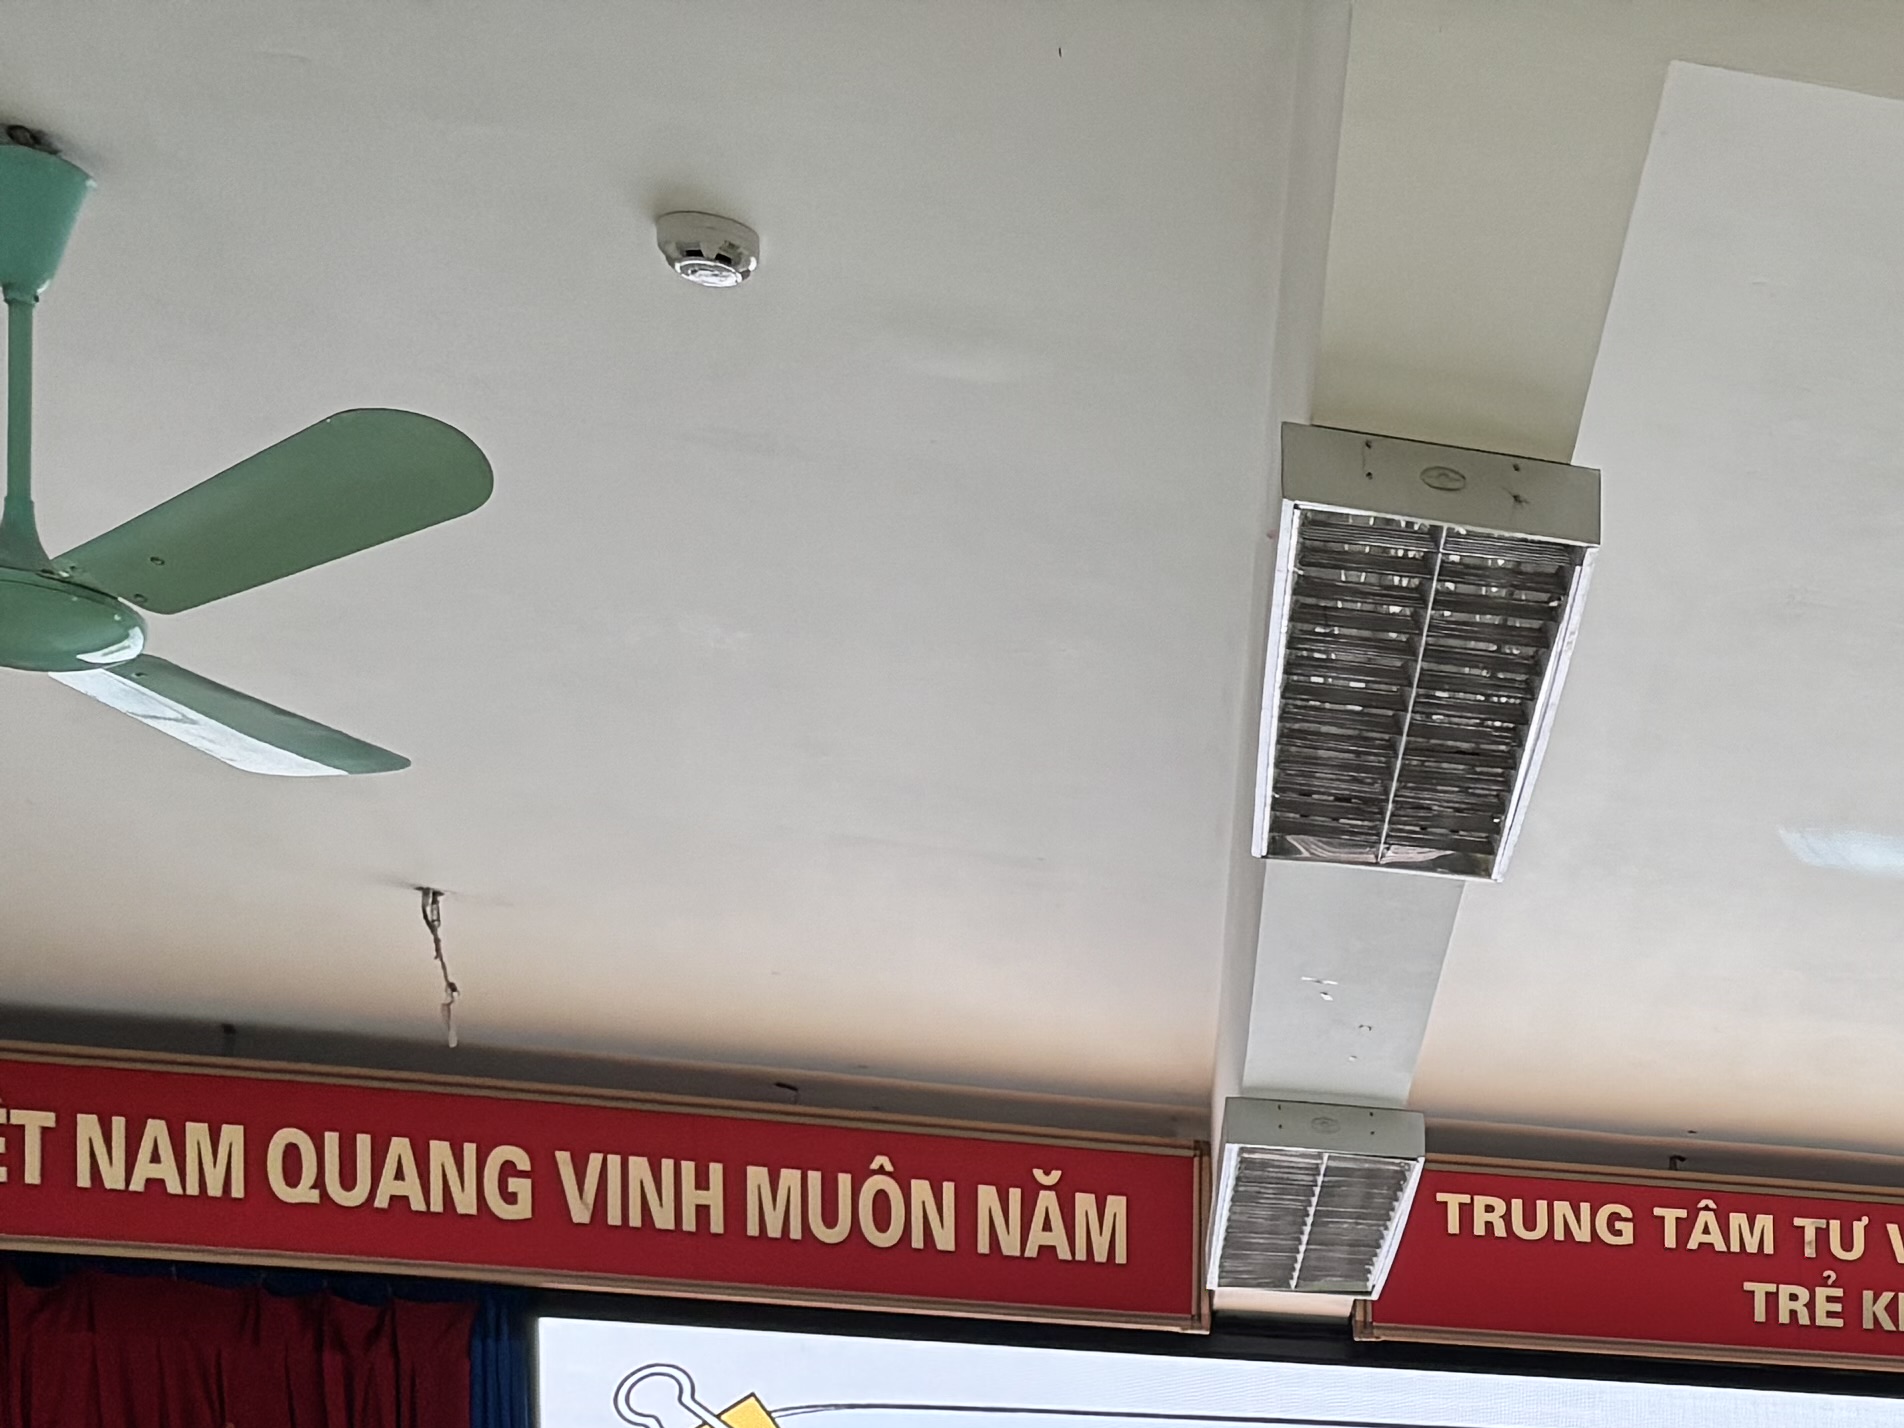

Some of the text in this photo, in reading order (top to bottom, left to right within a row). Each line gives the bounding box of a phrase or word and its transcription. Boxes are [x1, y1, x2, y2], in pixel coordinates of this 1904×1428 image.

[76, 1113, 245, 1199] NAM
[266, 1127, 533, 1220] QUANG
[554, 1150, 725, 1234] VINH
[746, 1154, 956, 1252] MUÔN
[977, 1168, 1127, 1264] NĂM
[1435, 1192, 1634, 1246] TRUNG
[1652, 1198, 1774, 1255] TÂM
[1792, 1214, 1869, 1261] TƯ
[1743, 1269, 1844, 1328] TRẺ
